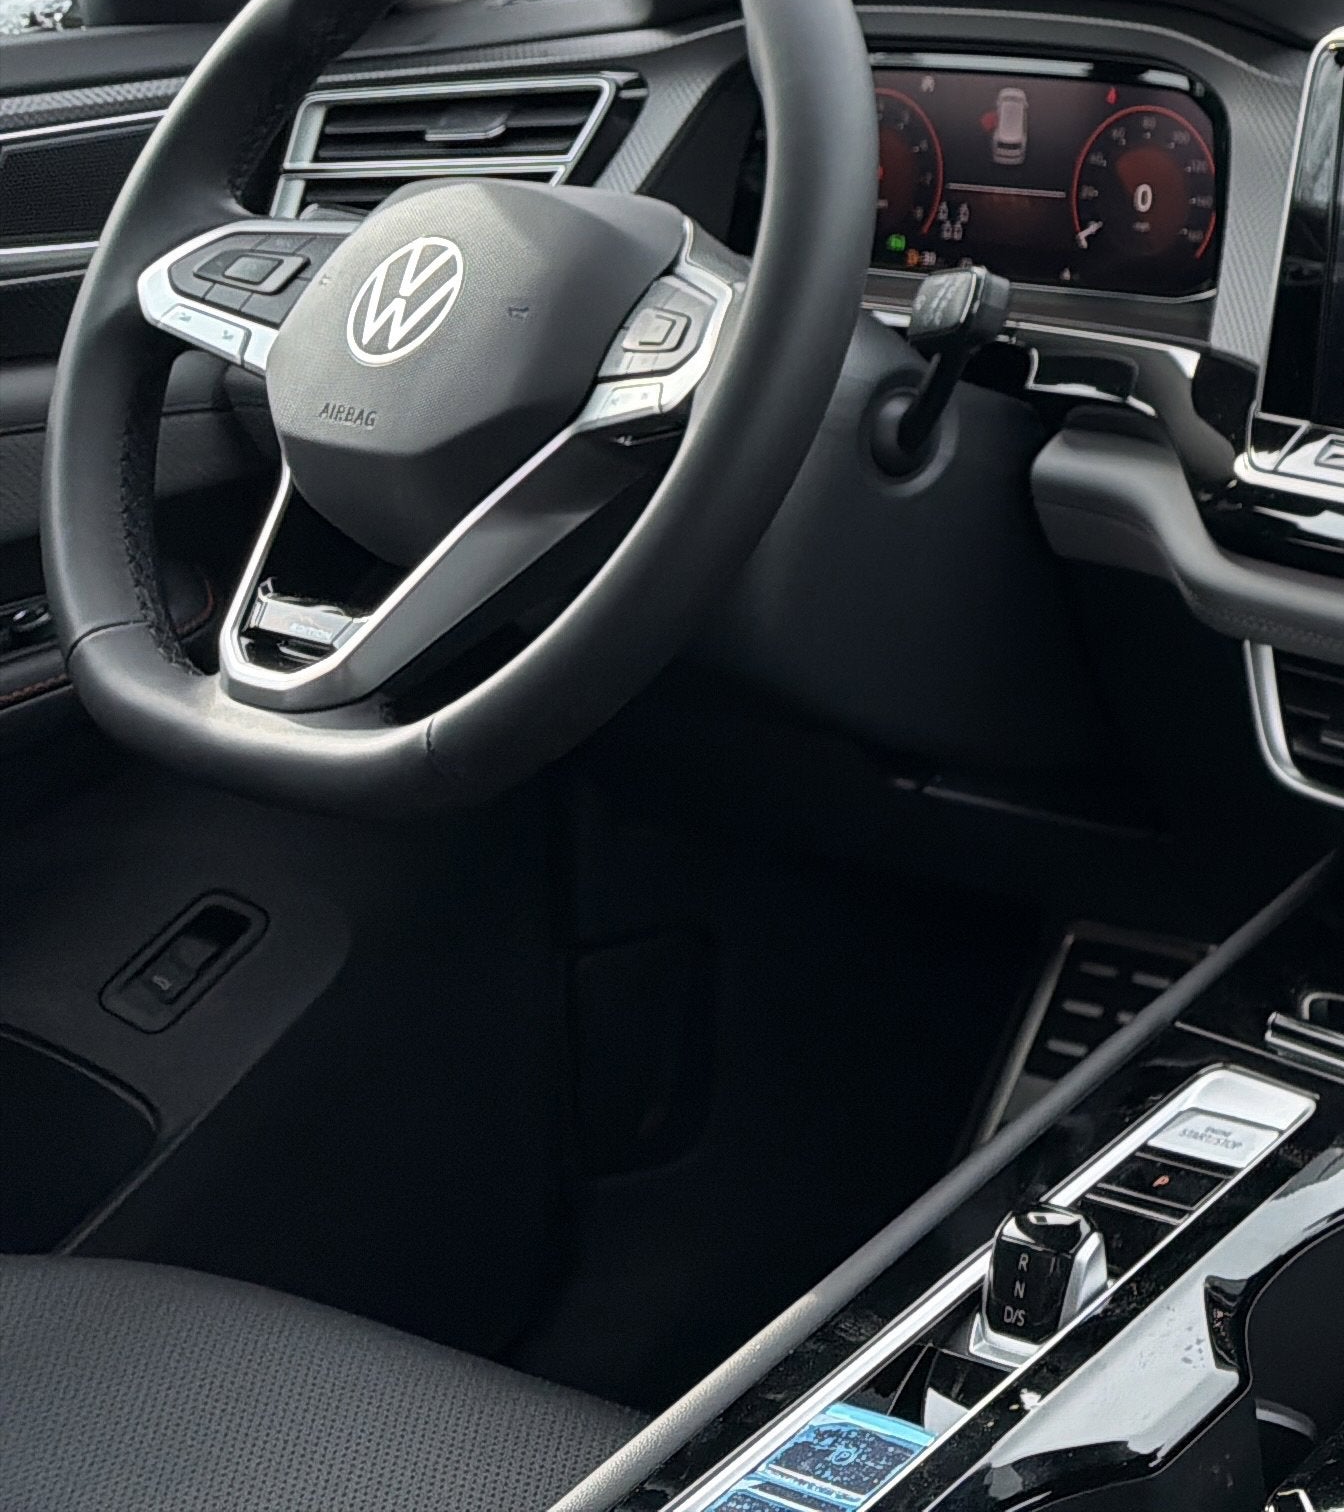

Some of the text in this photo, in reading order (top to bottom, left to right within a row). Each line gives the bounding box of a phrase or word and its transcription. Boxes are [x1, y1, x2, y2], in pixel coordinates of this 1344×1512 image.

[1133, 183, 1153, 213] 0
[319, 402, 378, 427] AIRBAG
[1018, 1252, 1029, 1272] R
[1013, 1279, 1026, 1299] N
[1003, 1305, 1027, 1327] D/S
